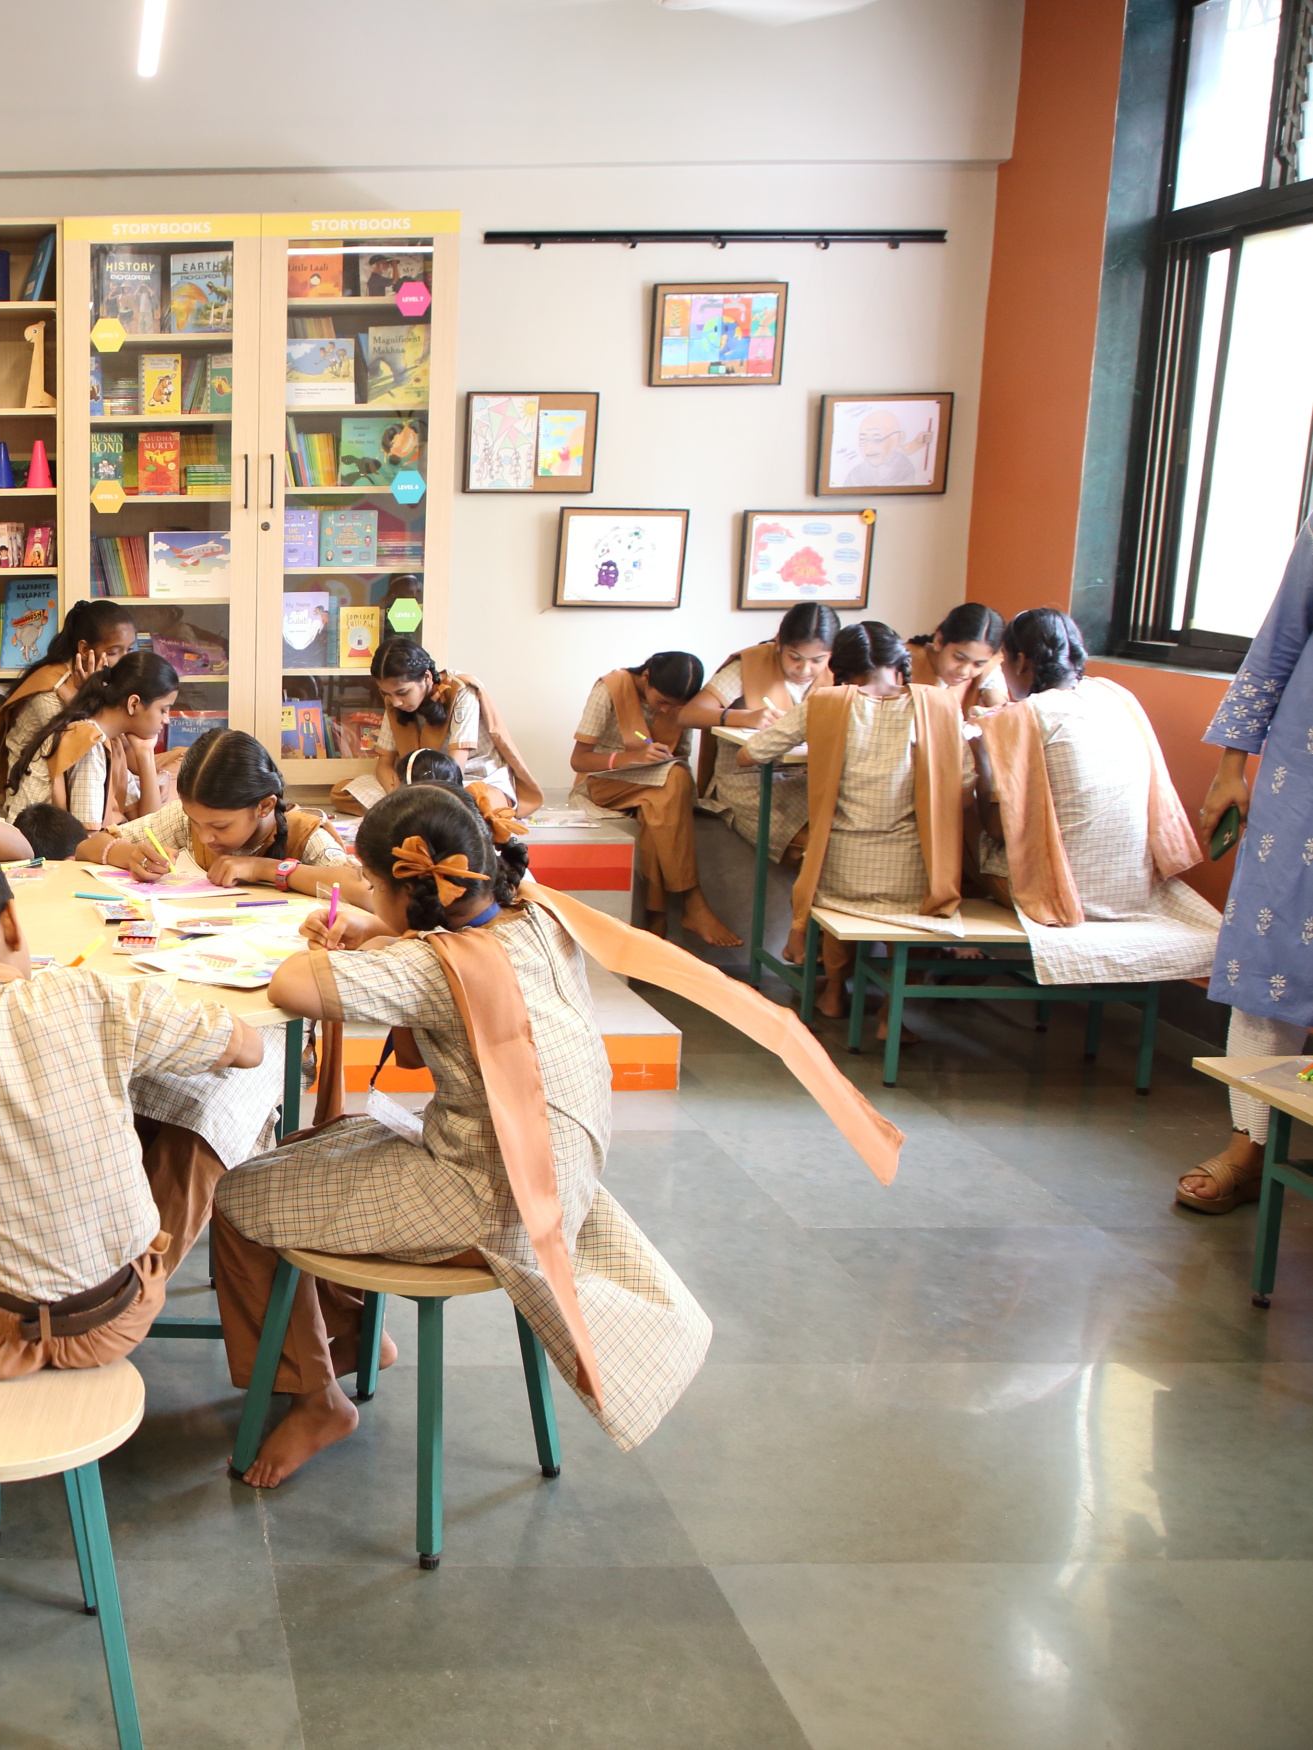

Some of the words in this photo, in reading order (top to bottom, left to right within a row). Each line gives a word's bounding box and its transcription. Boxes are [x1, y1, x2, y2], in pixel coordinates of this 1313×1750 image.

[112, 222, 212, 235] STORYBOOKS
[311, 218, 411, 231] STORYBOOKS
[106, 262, 155, 272] HISTORY
[182, 261, 221, 272] EARTH
[310, 263, 328, 271] Laali
[373, 335, 421, 344] Magnificent
[91, 434, 123, 443] RUSKIN
[91, 443, 124, 453] BOND
[287, 616, 308, 624] Gulab
